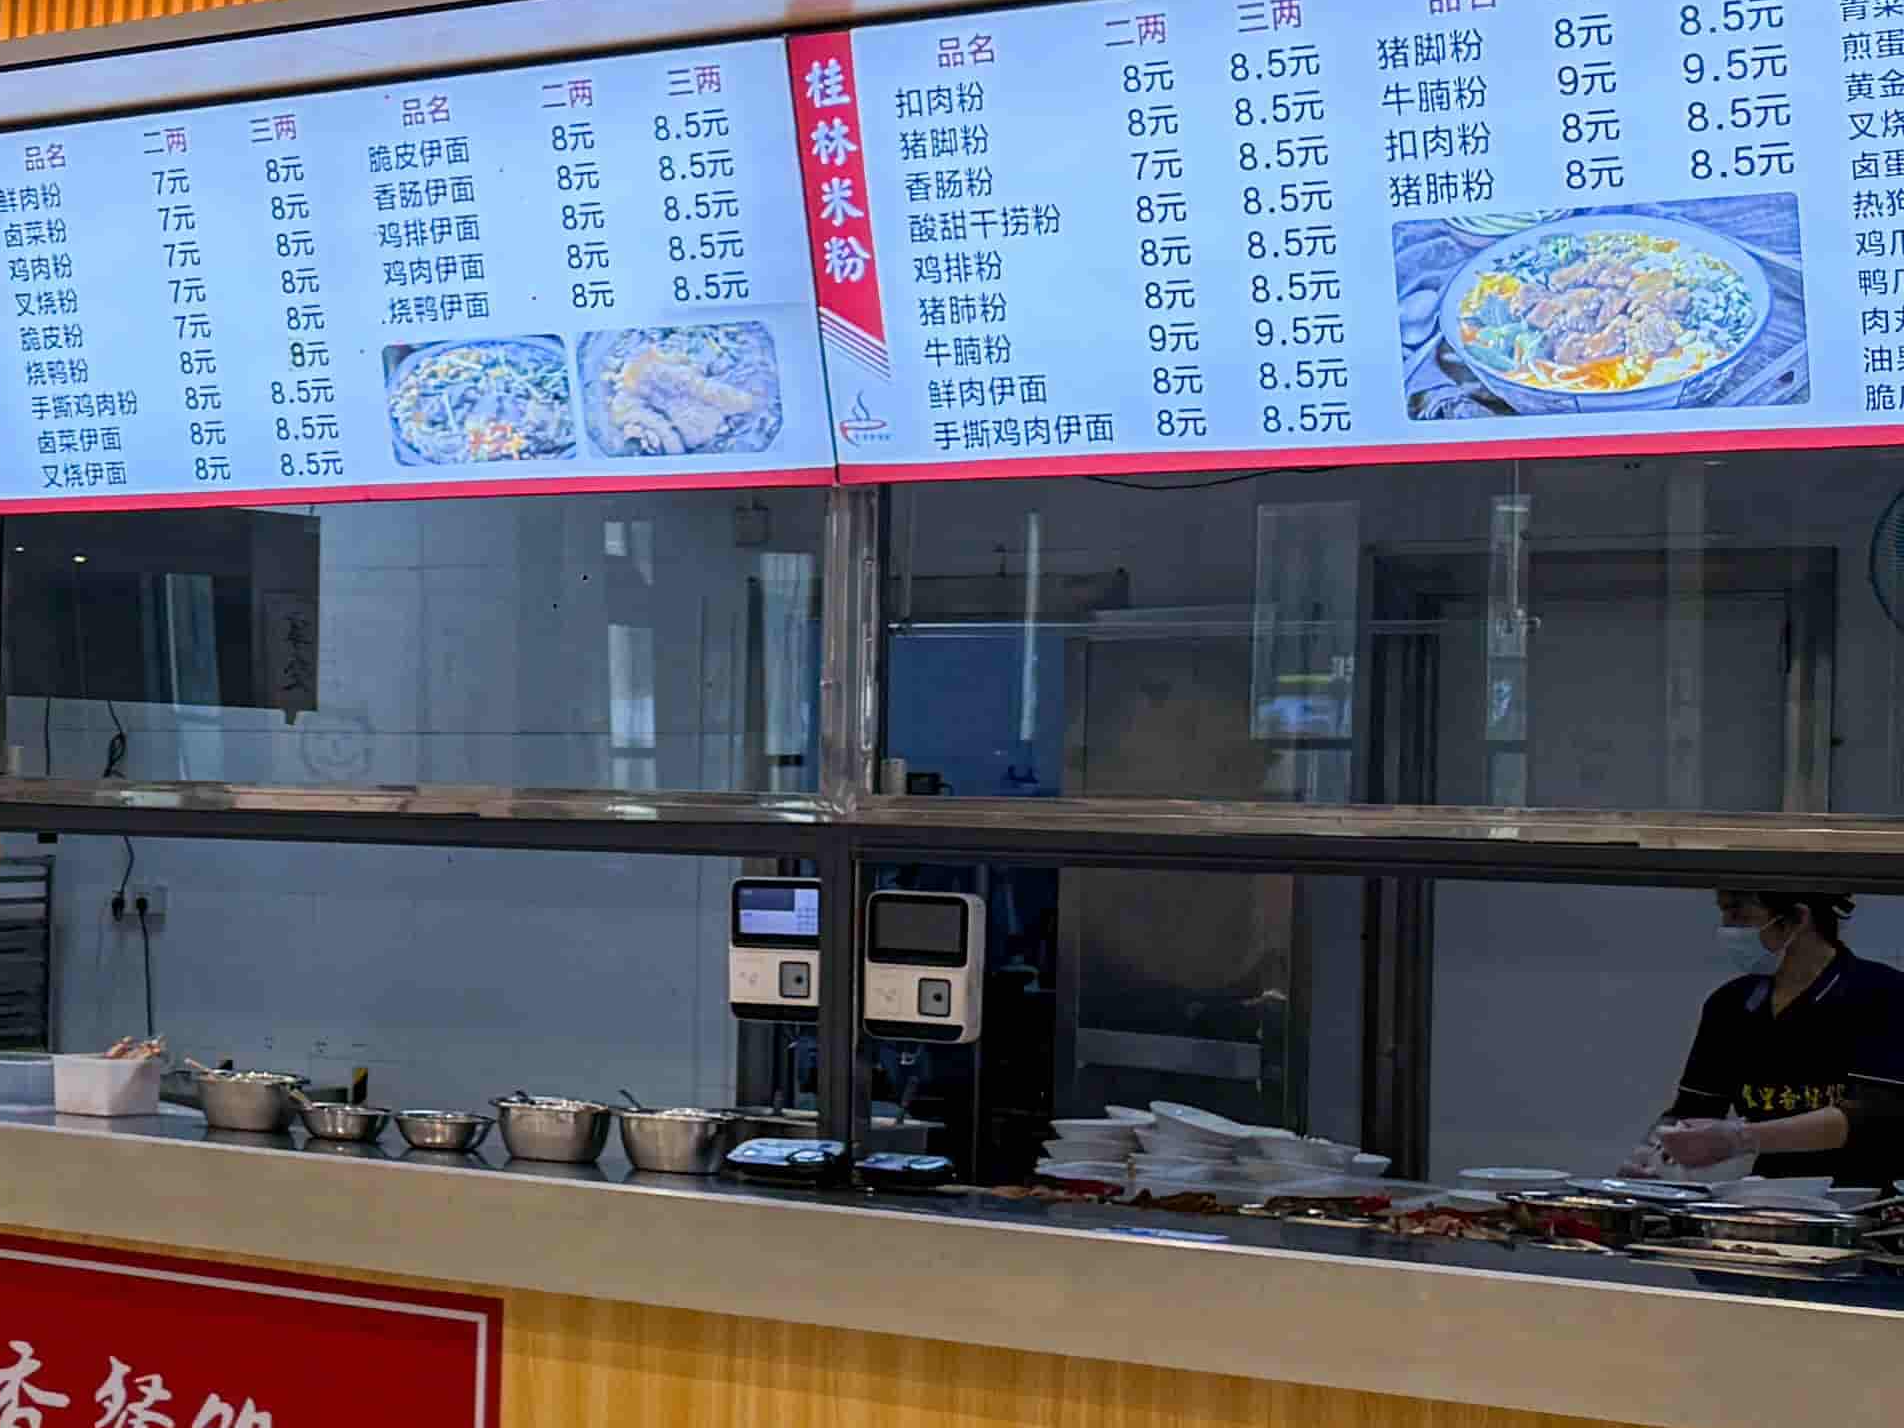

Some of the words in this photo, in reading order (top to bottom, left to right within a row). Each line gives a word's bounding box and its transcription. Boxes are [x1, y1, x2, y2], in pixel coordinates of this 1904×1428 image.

[937, 33, 996, 69] 品名
[1104, 13, 1168, 48] 二两
[1377, 26, 1485, 71] 猪脚粉
[1553, 12, 1614, 50] 8元
[402, 95, 451, 127] 品名
[541, 79, 593, 110] 二两
[667, 66, 721, 98] 三两
[895, 81, 984, 119] 扣肉粉
[1122, 60, 1175, 94] 8元
[1229, 44, 1320, 82] 8.5元
[1381, 75, 1487, 117] 牛腩粉
[1556, 61, 1617, 97] 9元
[1682, 44, 1788, 86] 9.5元
[24, 144, 66, 172] 品名
[144, 127, 187, 155] 二两
[250, 114, 297, 144] 三两
[368, 136, 470, 172] 脆皮伊面
[552, 123, 595, 152] 8元
[654, 110, 729, 141] 8.5元
[900, 124, 990, 161] 猪脚粉
[1128, 105, 1178, 139] 8元
[1234, 89, 1324, 127] 8.5元
[1385, 121, 1492, 164] 扣肉粉
[1560, 109, 1621, 144] 8元
[1686, 92, 1791, 133] 8.5元
[152, 168, 190, 196] 7元
[266, 156, 304, 184] 8元
[373, 175, 475, 213] 香肠伊面
[556, 163, 600, 192] 8元
[658, 150, 734, 182] 8.5元
[805, 57, 872, 285] 桂林米粉
[904, 166, 992, 204] 香肠粉
[1131, 148, 1183, 180] 7元
[1240, 134, 1328, 172] 8.5元
[1389, 166, 1495, 209] 猪肺粉
[1565, 156, 1624, 191] 8元
[1690, 141, 1795, 181] 8.5元
[4, 218, 67, 249] 卤菜粉
[158, 204, 195, 232] 7元
[271, 193, 309, 220] 8元
[378, 214, 480, 250] 鸡排伊面
[562, 202, 605, 230] 8元
[664, 190, 739, 222] 8.5元
[909, 203, 1061, 244] 酸甜干捞粉
[1136, 192, 1187, 225] 8元
[1243, 180, 1333, 216] 8.5元
[9, 252, 72, 283] 鸡肉粉
[163, 241, 200, 268] 7元
[276, 230, 315, 258] 8元
[383, 252, 485, 286] 鸡肉伊面
[567, 241, 609, 270] 8元
[668, 230, 744, 261] 8.5元
[914, 251, 1002, 284] 鸡排粉
[1140, 236, 1192, 268] 8元
[1247, 224, 1336, 260] 8.5元
[15, 288, 78, 316] 叉烧粉
[168, 277, 206, 304] 7元
[281, 268, 320, 294] 8元
[389, 292, 490, 324] 烧鸭伊面
[572, 280, 615, 309] 8元
[673, 270, 750, 302] 8.5元
[918, 292, 1007, 328] 猪肺粉
[1144, 279, 1196, 311] 8元
[1250, 269, 1341, 304] 8.5元
[20, 324, 83, 352] 脆皮粉
[173, 314, 212, 340] 7元
[286, 304, 325, 332] 8元
[924, 334, 1012, 369] 牛腩粉
[1148, 321, 1200, 354] 9元
[1255, 313, 1344, 348] 9.5元
[26, 358, 88, 386] 烧鸭粉
[180, 350, 216, 377] 8元
[928, 374, 1048, 412] 鲜肉伊面
[1152, 364, 1203, 396] 8元
[1258, 356, 1349, 392] 8.5元
[32, 390, 138, 421] 手撕鸡肉粉
[185, 386, 222, 412] 8元
[271, 378, 335, 404] 8.5元
[933, 412, 1115, 452] 手撕鸡肉伊面
[1157, 408, 1207, 439] 8元
[1262, 400, 1353, 435] 8.5元
[37, 426, 122, 454] 卤菜伊面
[190, 421, 226, 447] 8元
[276, 414, 339, 442] 8.5元
[42, 461, 127, 490] 叉烧伊面
[195, 456, 231, 482] 8元
[280, 450, 344, 477] 8.5元
